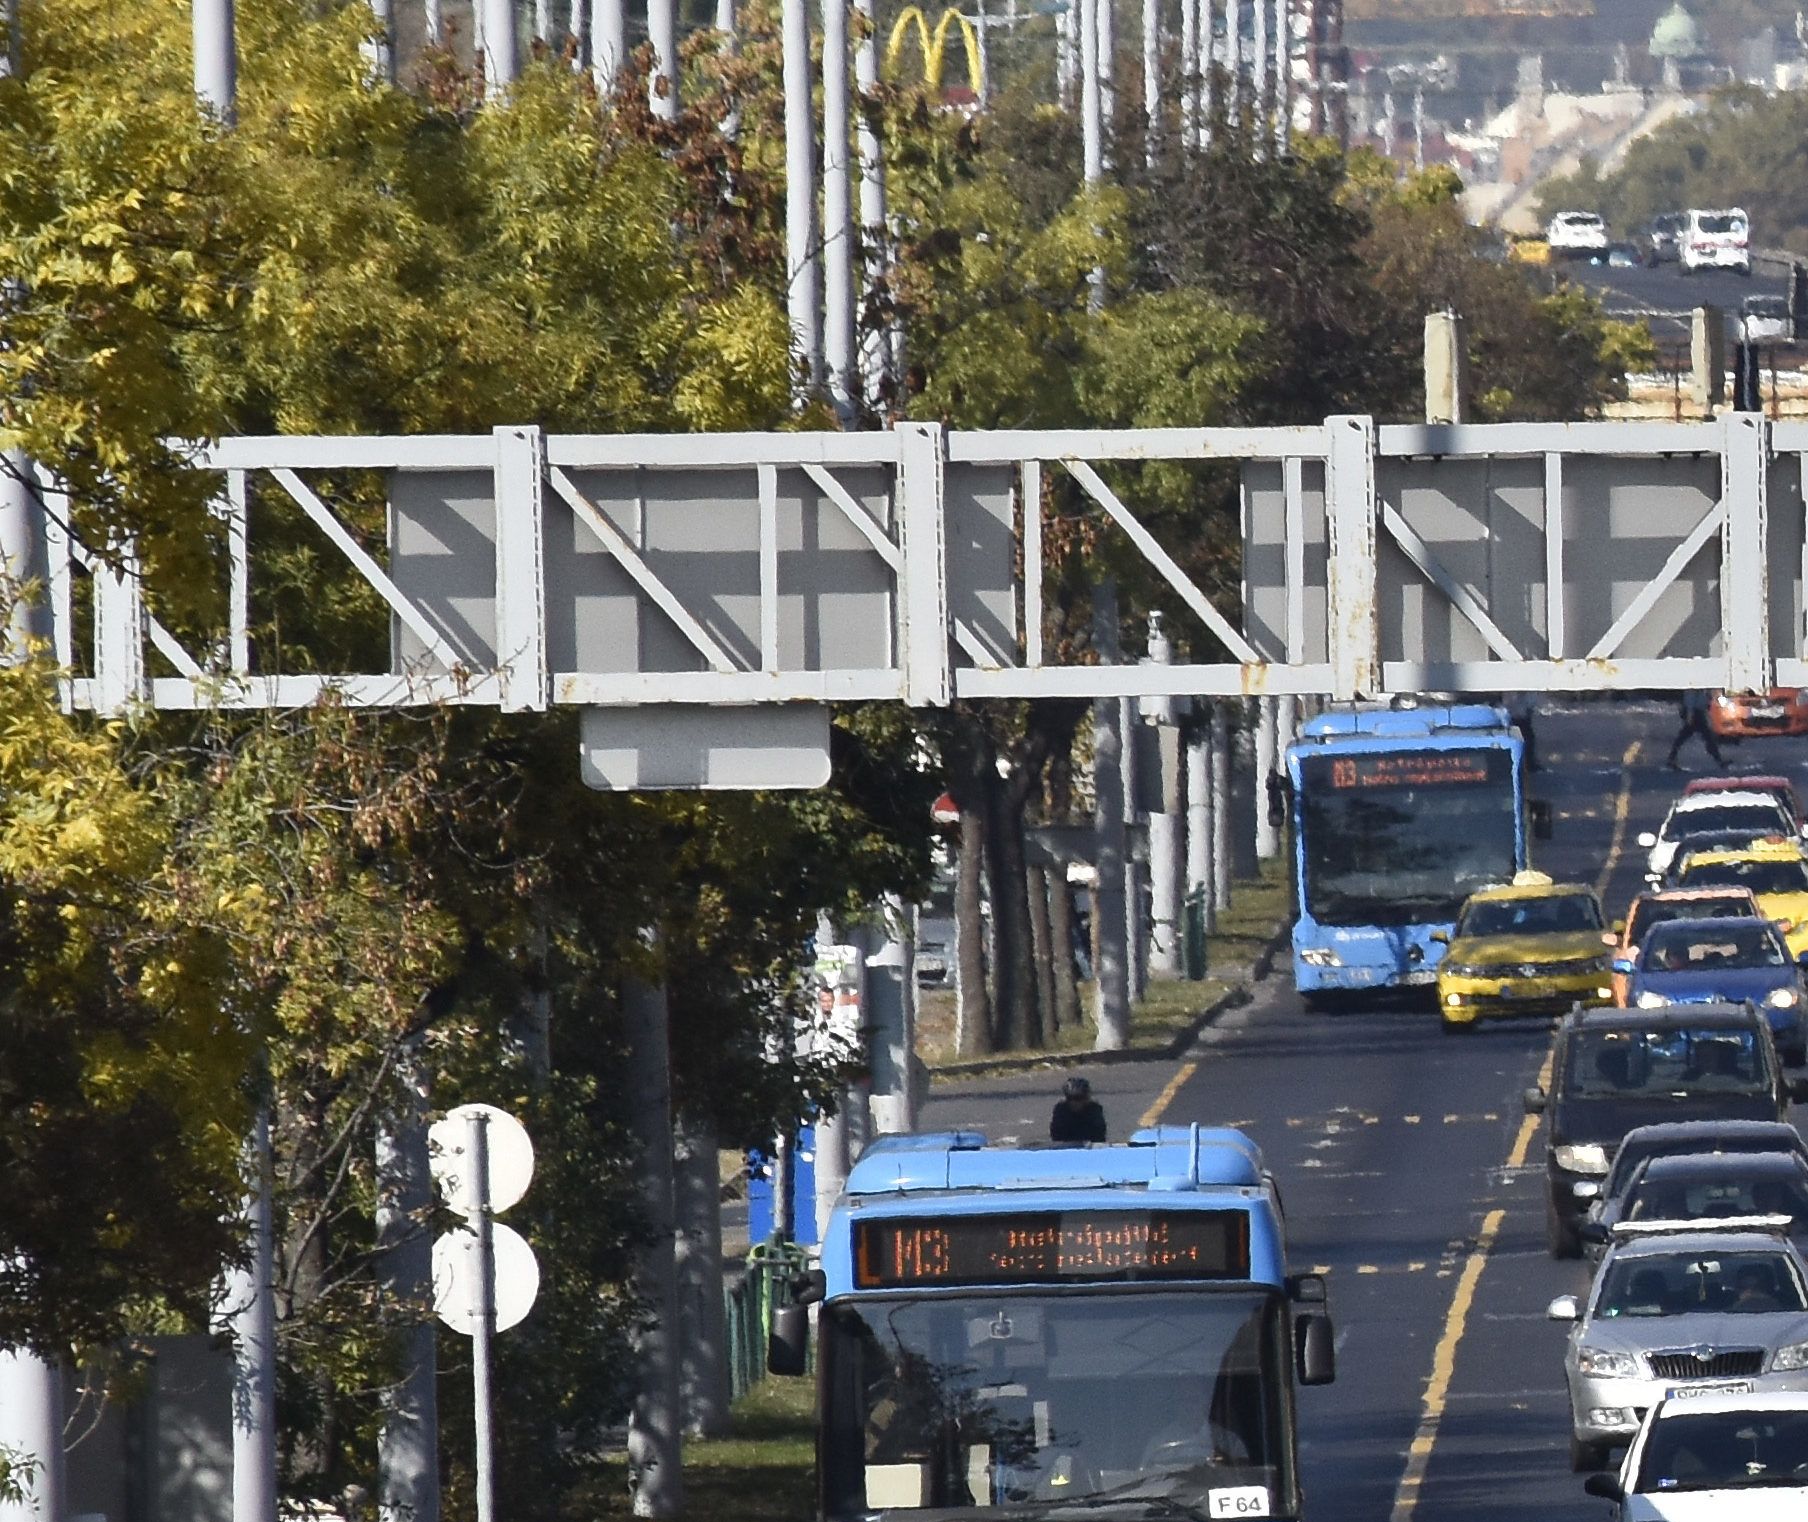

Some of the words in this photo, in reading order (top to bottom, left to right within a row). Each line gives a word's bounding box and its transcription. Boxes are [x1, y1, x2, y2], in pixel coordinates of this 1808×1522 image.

[895, 1229, 948, 1276] M3
[1218, 1498, 1232, 1513] F
[1237, 1497, 1261, 1512] 64
